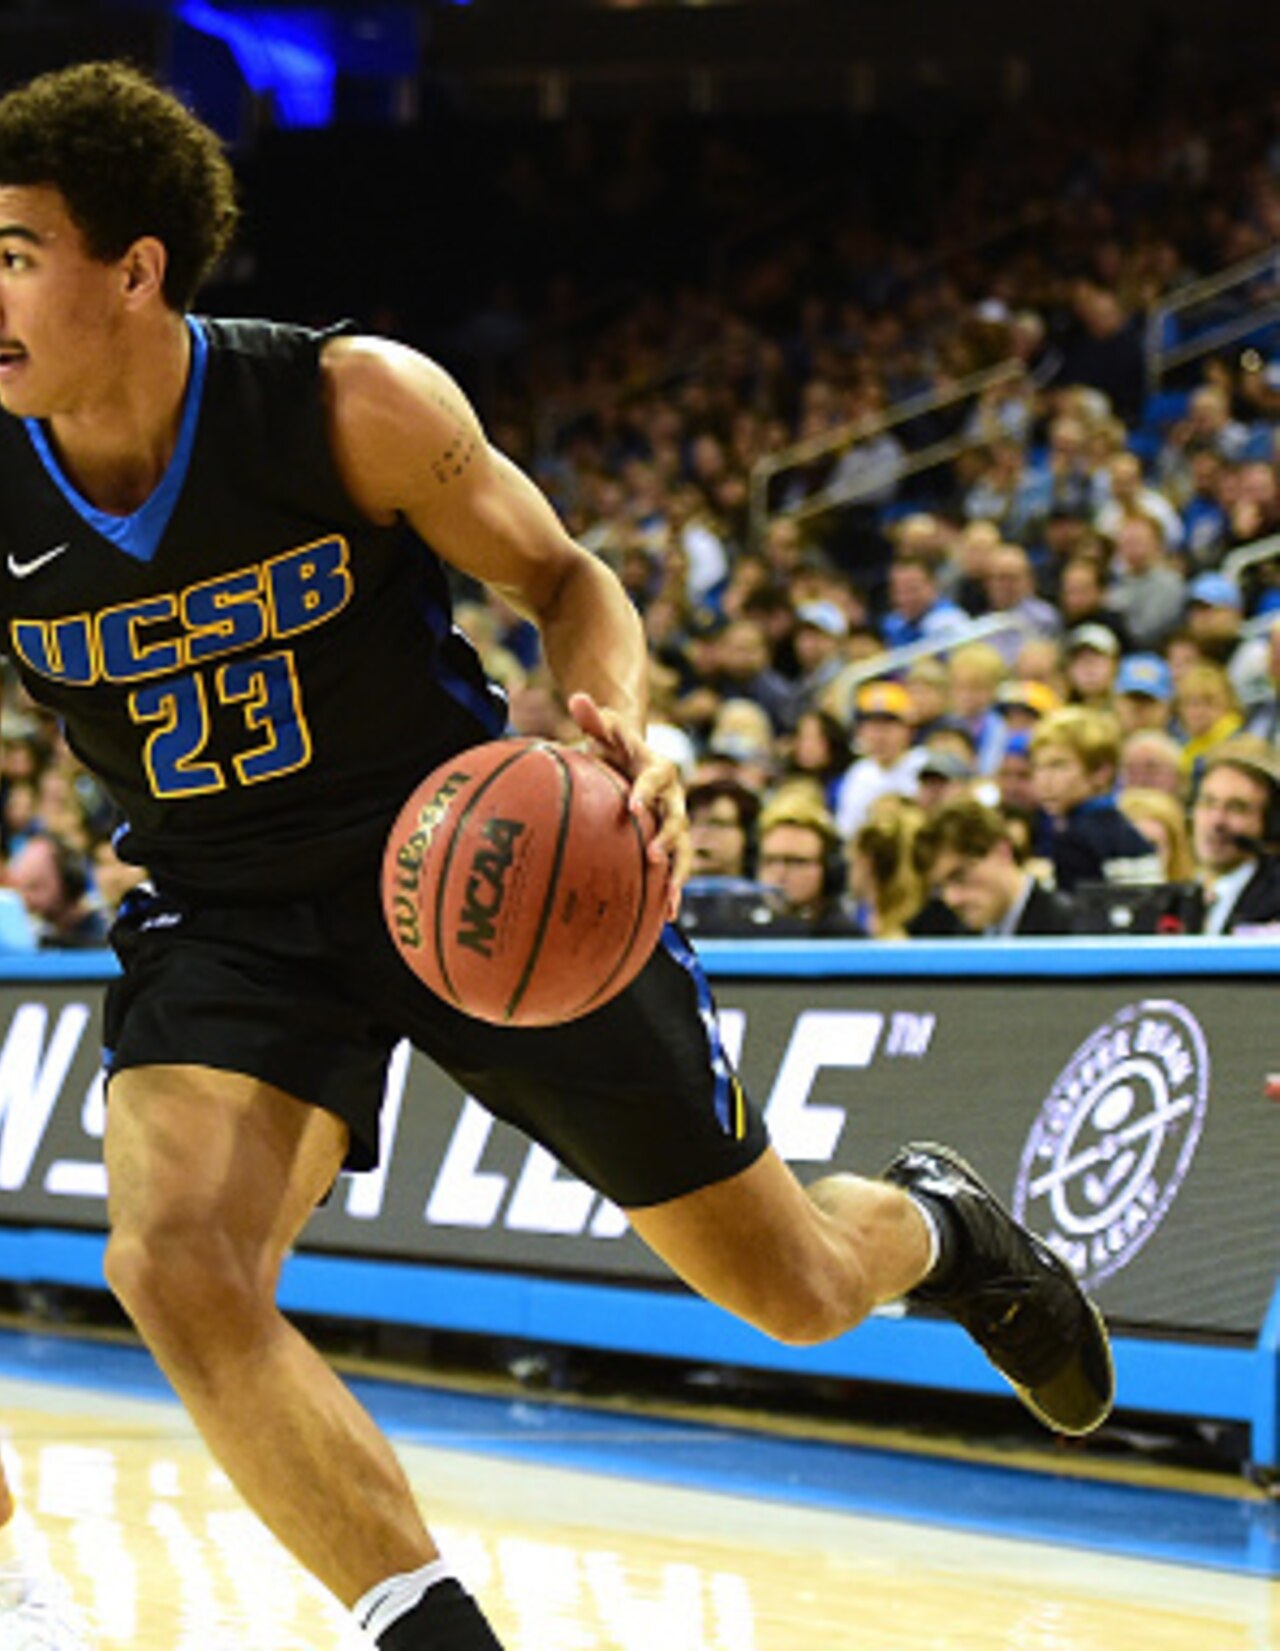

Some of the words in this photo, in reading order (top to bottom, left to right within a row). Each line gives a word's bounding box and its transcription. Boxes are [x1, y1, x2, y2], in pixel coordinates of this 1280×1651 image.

[11, 533, 354, 687] UCSB
[128, 649, 313, 800] 23
[456, 817, 526, 959] NCAA
